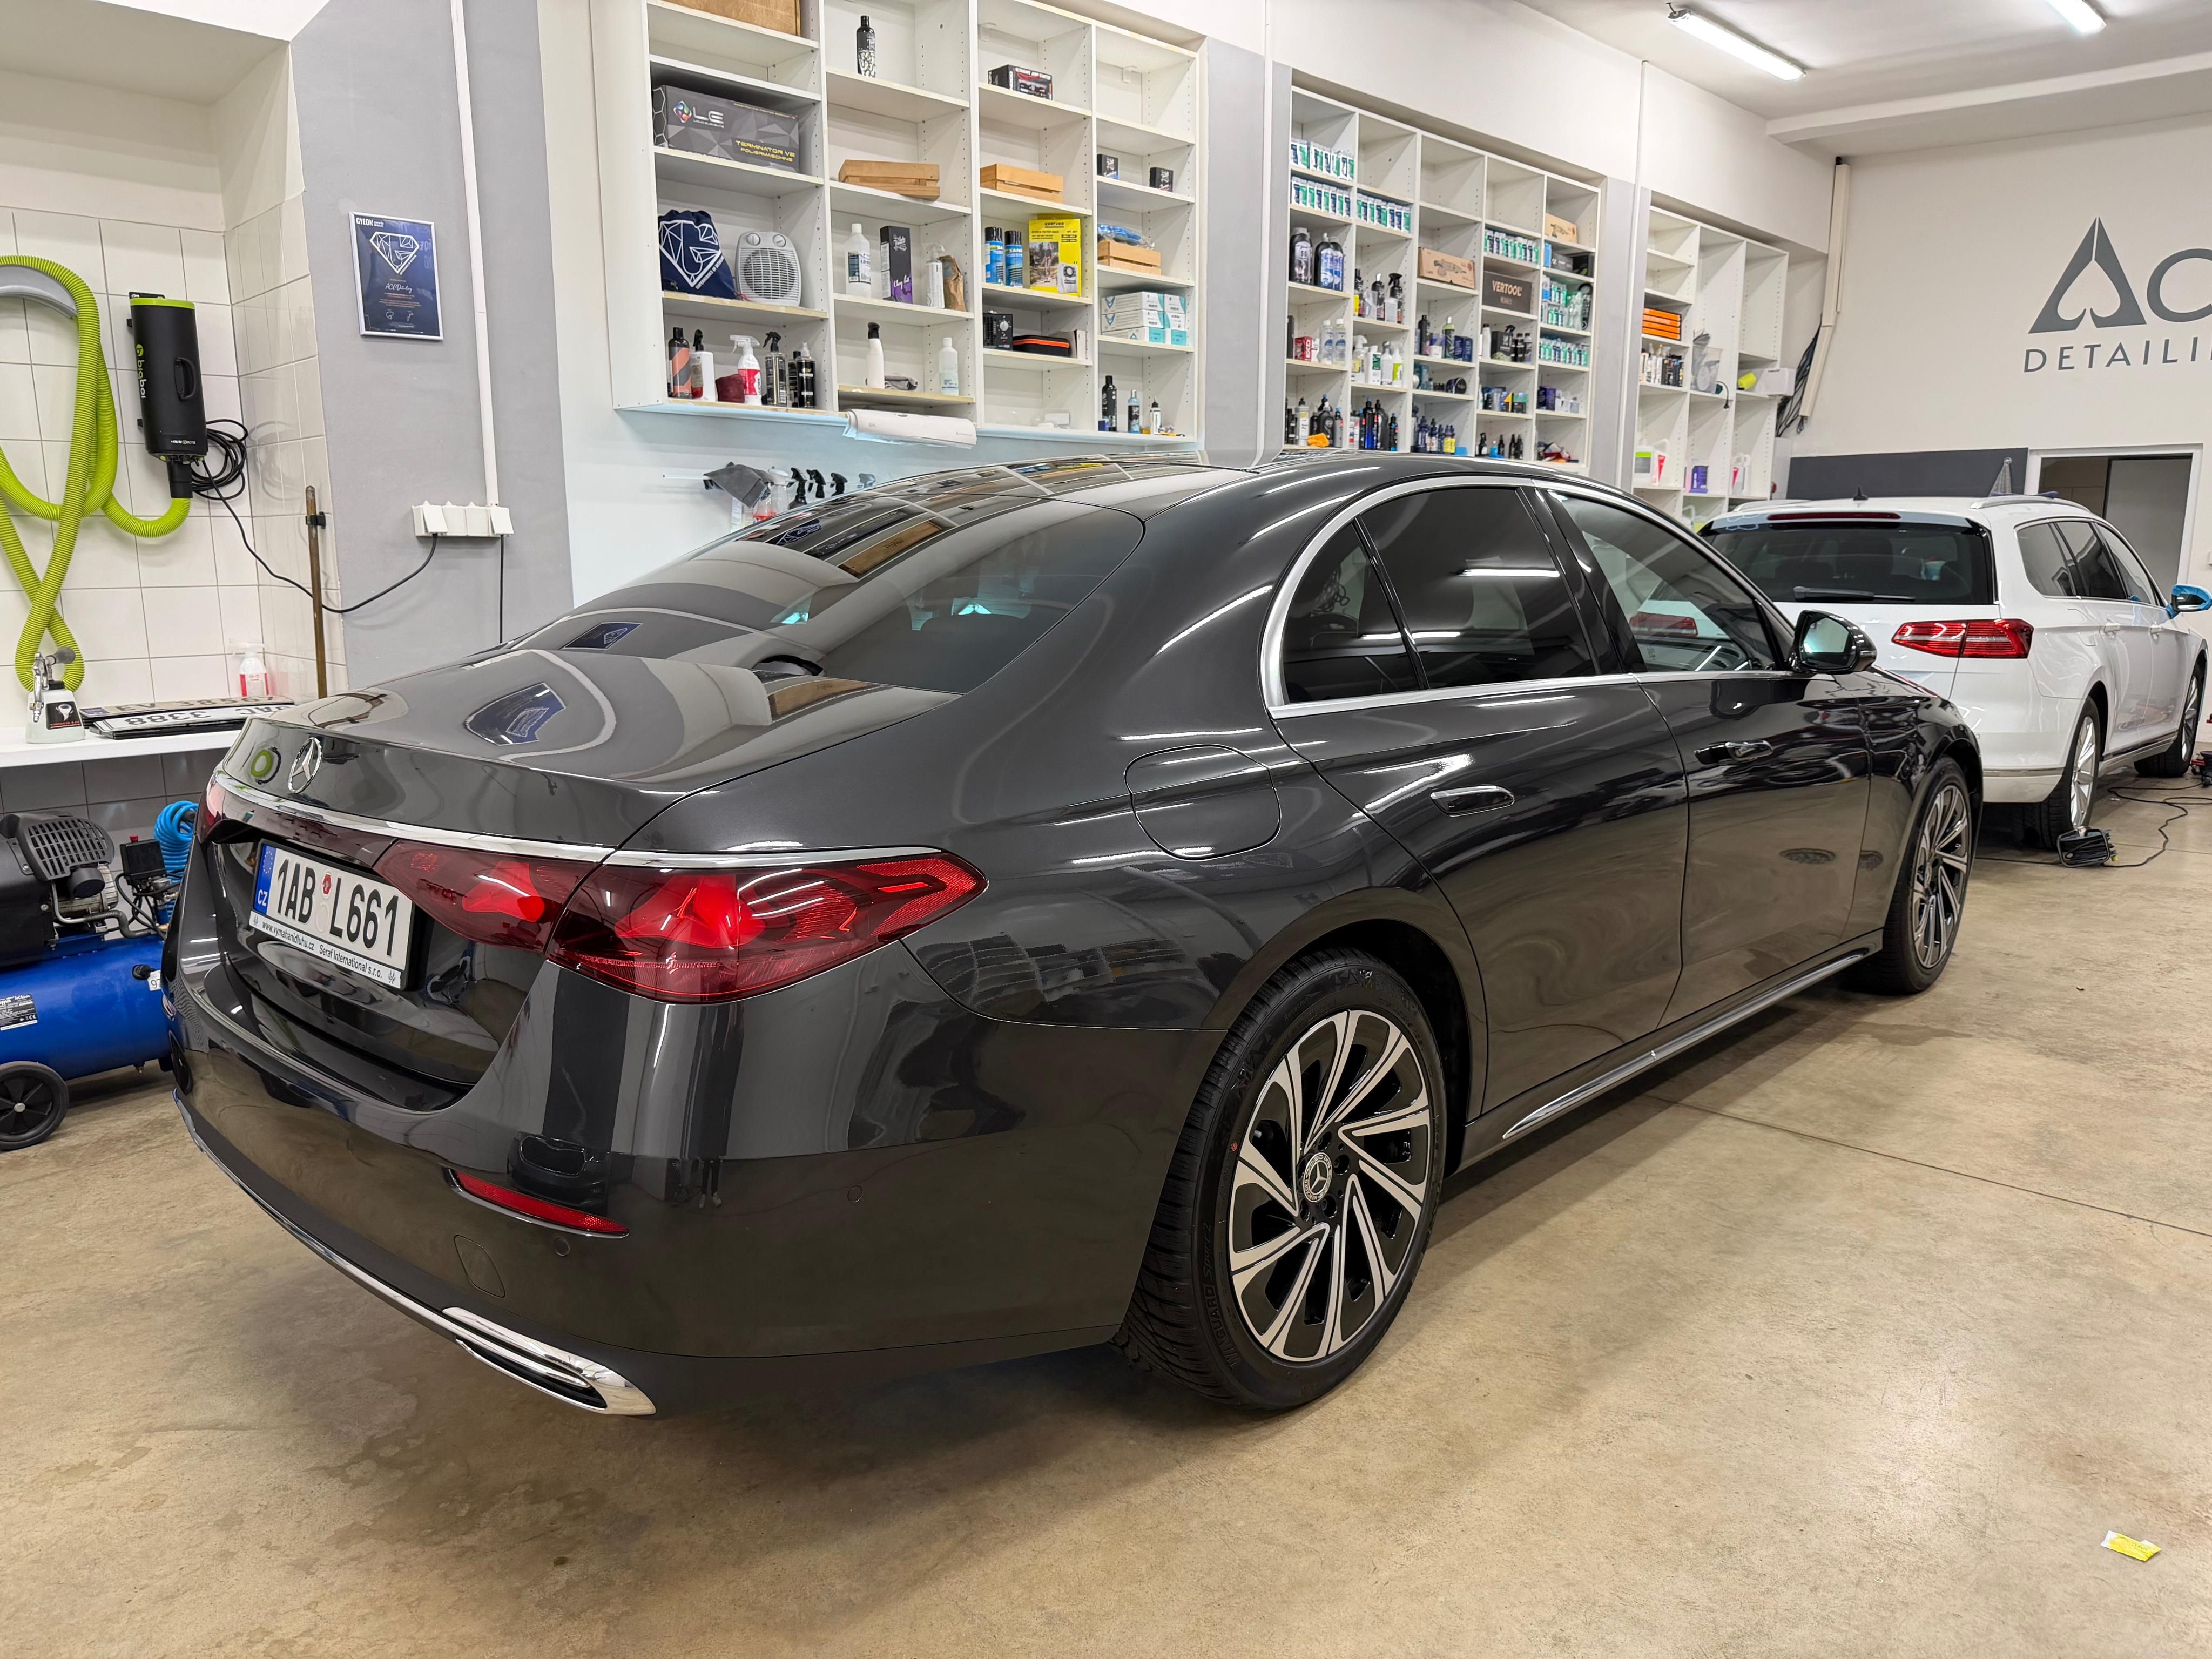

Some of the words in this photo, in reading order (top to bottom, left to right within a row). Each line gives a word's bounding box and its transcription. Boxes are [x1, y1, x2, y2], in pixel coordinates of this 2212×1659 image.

[735, 140, 783, 155] TERMINATOR
[355, 217, 374, 227] GYEON
[1492, 280, 1521, 297] VERTOOL
[2024, 337, 2212, 373] DETAILI
[257, 889, 268, 907] CZ
[276, 859, 316, 923] 1AB
[329, 877, 399, 956] L661
[262, 921, 315, 952] www.vymahanidluhu.cz
[319, 945, 332, 959] Seraf
[332, 948, 367, 974] International
[367, 964, 383, 979] s.r.o.
